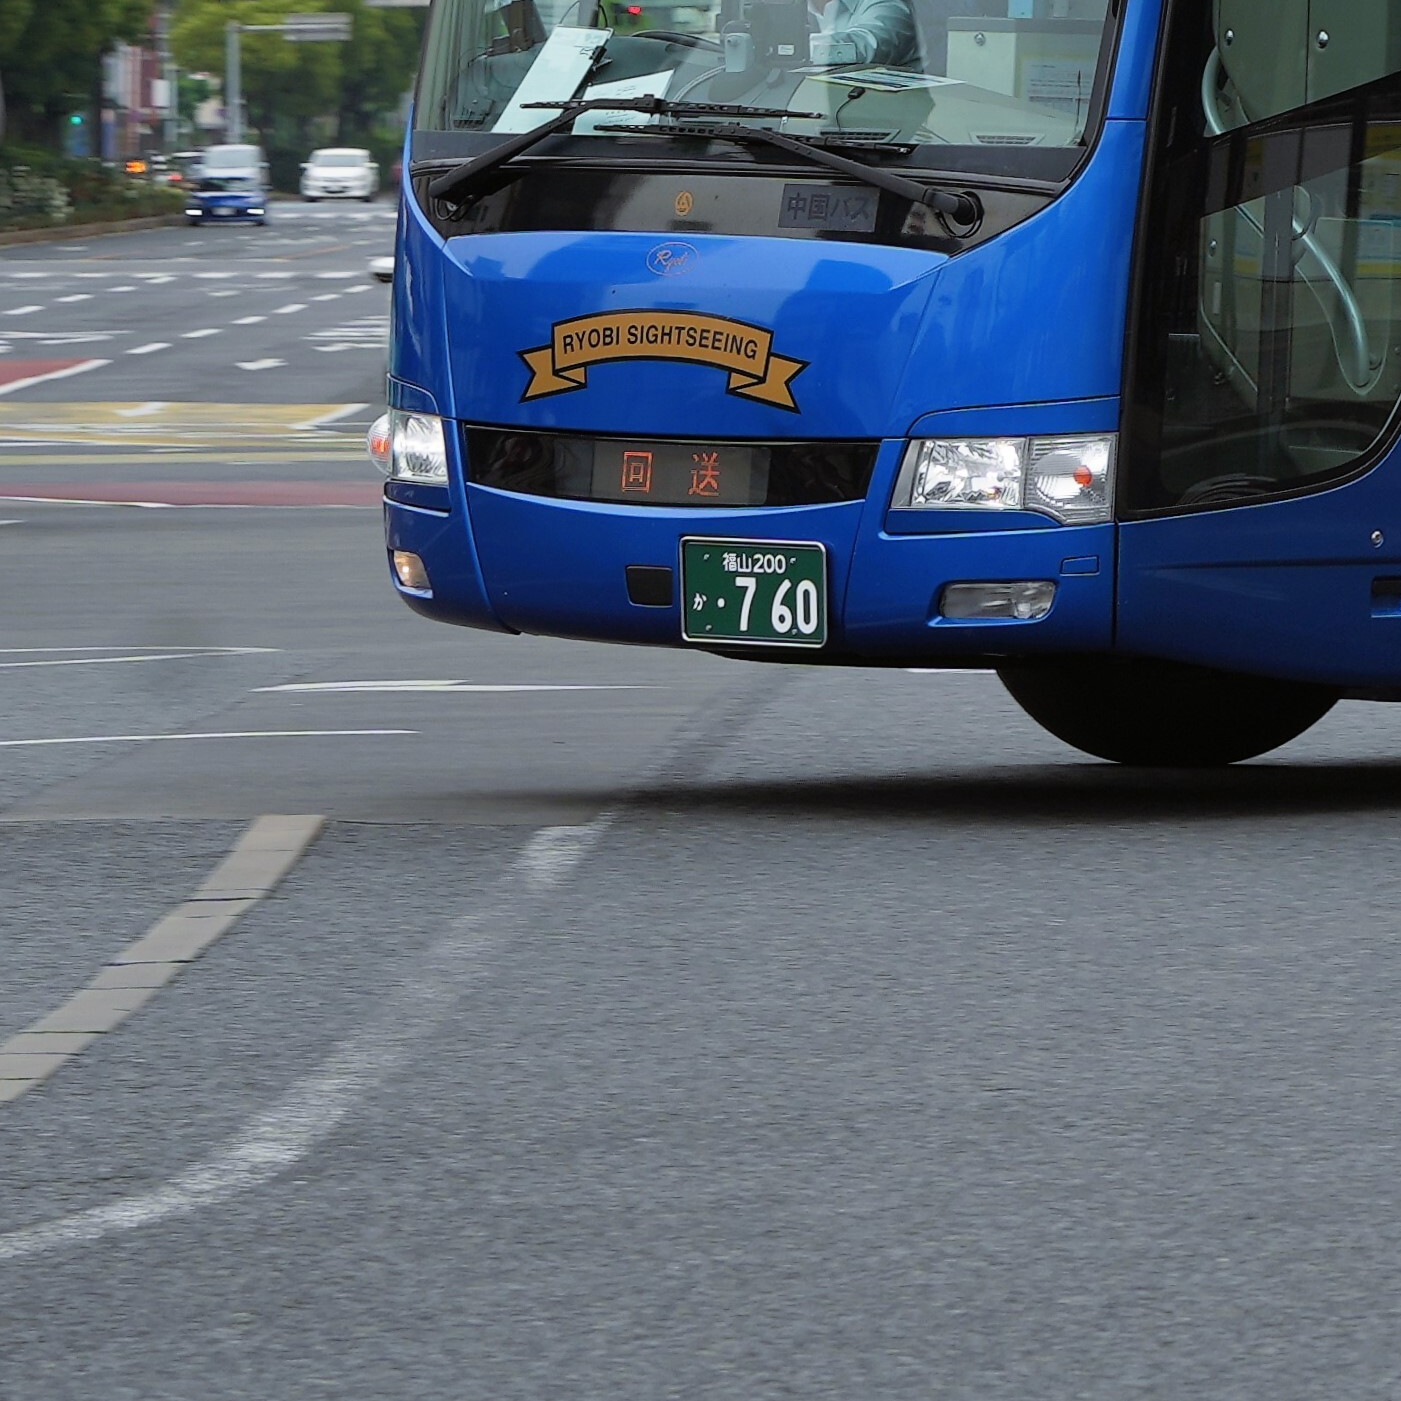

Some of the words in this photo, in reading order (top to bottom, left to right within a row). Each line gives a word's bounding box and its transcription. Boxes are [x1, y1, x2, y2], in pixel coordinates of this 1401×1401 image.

[787, 192, 871, 222] 中国バス
[562, 325, 620, 355] RYOBI
[626, 324, 759, 361] SIGHTSEEING
[692, 592, 708, 611] か
